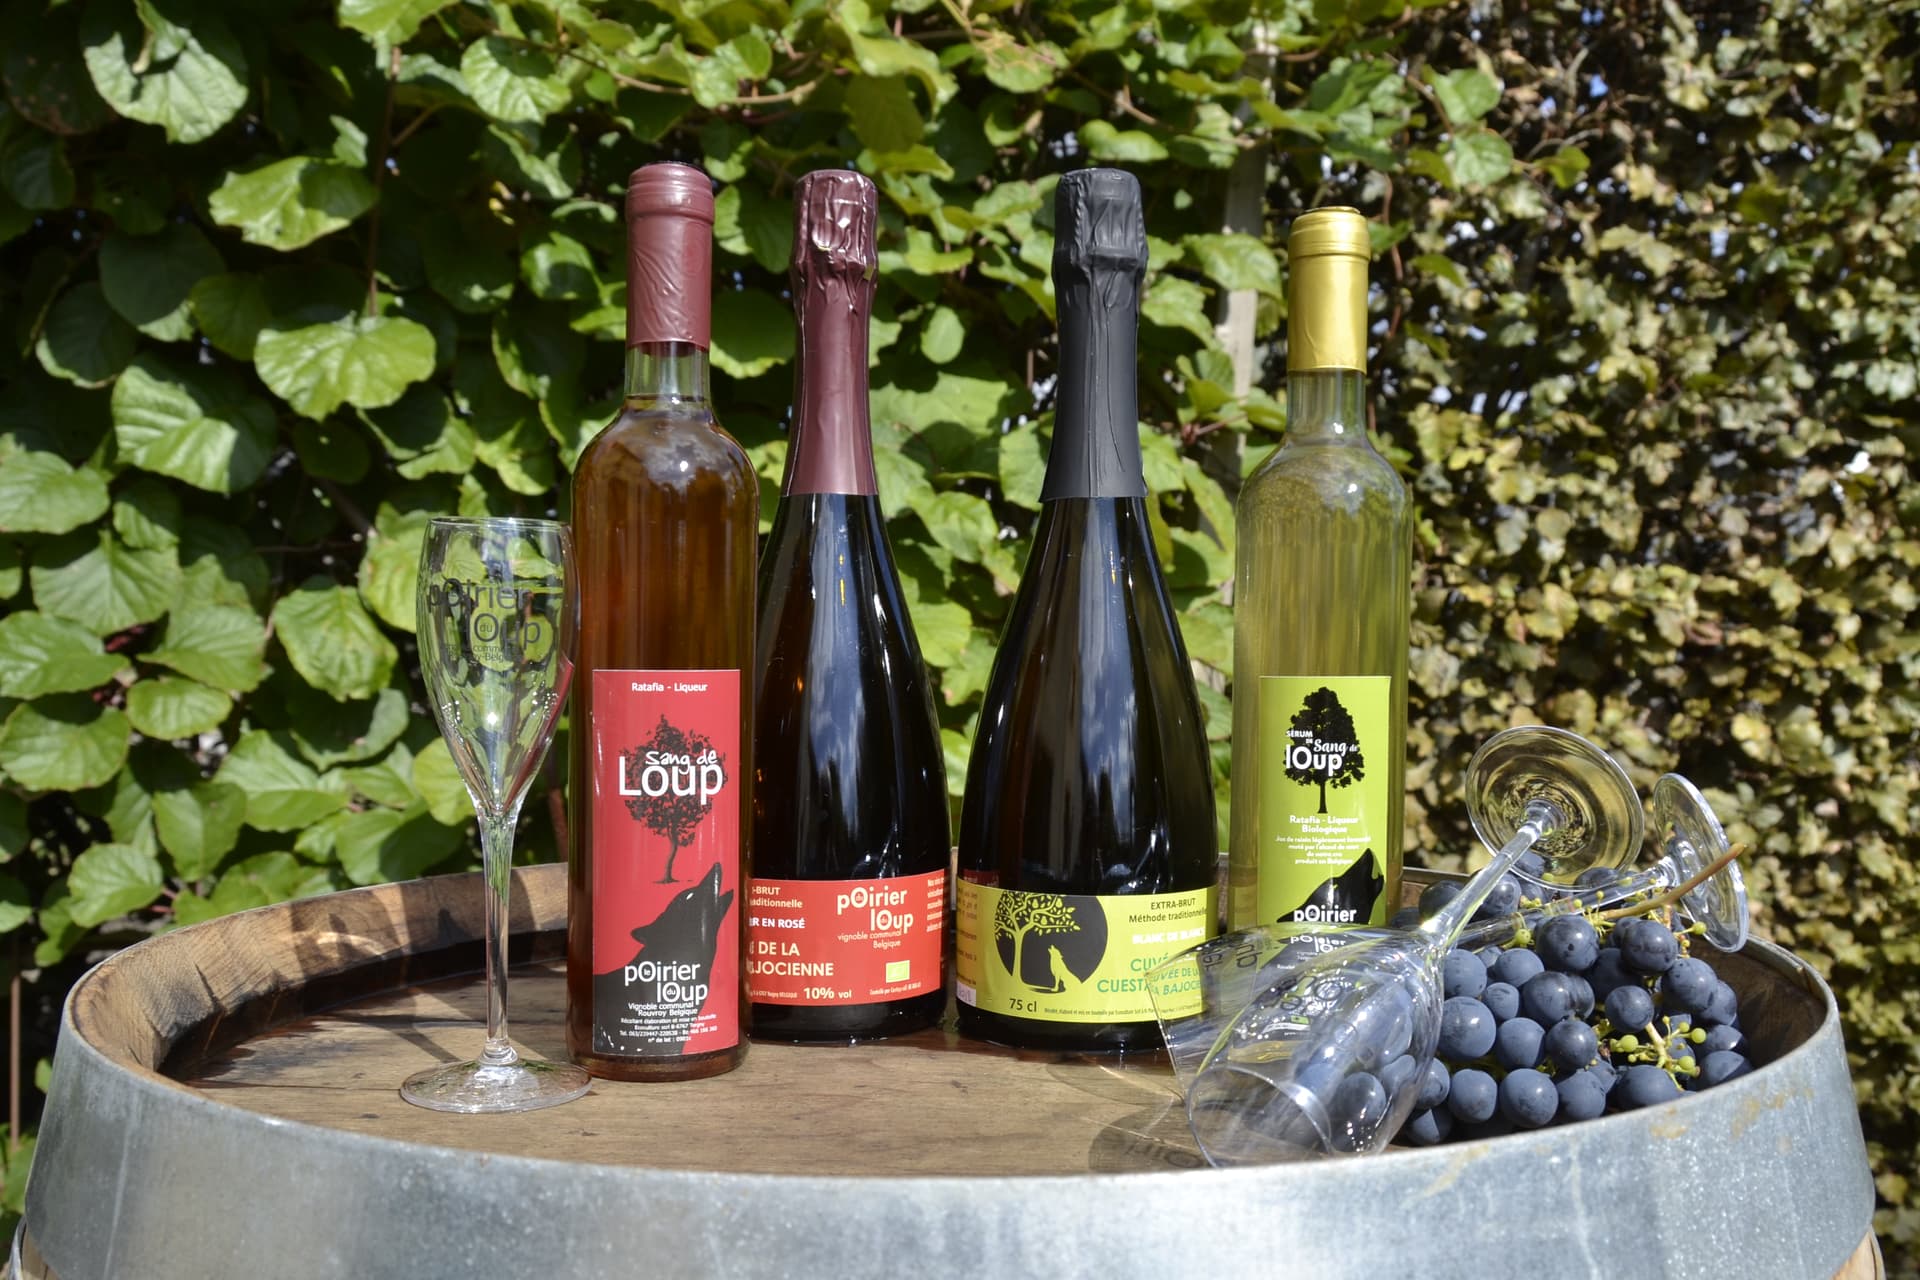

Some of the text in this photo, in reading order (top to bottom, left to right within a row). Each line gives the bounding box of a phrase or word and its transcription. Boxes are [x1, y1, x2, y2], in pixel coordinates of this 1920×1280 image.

[631, 682, 664, 692] Ratafia
[674, 682, 708, 693] Liqueur
[1313, 738, 1347, 757] Sang
[645, 749, 718, 775] Sang de
[618, 756, 724, 806] Loup
[1289, 814, 1320, 824] Ratafia
[1327, 815, 1359, 825] Liqueur
[1302, 824, 1348, 834] Biologique
[1150, 898, 1196, 911] EXTRA-BRUT
[761, 918, 776, 928] EN
[777, 917, 806, 929] ROSÉ
[1129, 914, 1167, 924] Méthode
[837, 931, 868, 944] vignoble
[758, 941, 777, 956] DE
[781, 942, 800, 956] LA
[873, 940, 901, 950] Belgique
[803, 985, 852, 1000] 10% vol
[628, 1001, 694, 1012] Vignoble communal
[1009, 998, 1037, 1012] 75 cl
[638, 1008, 698, 1018] Rouvroy Belgique
